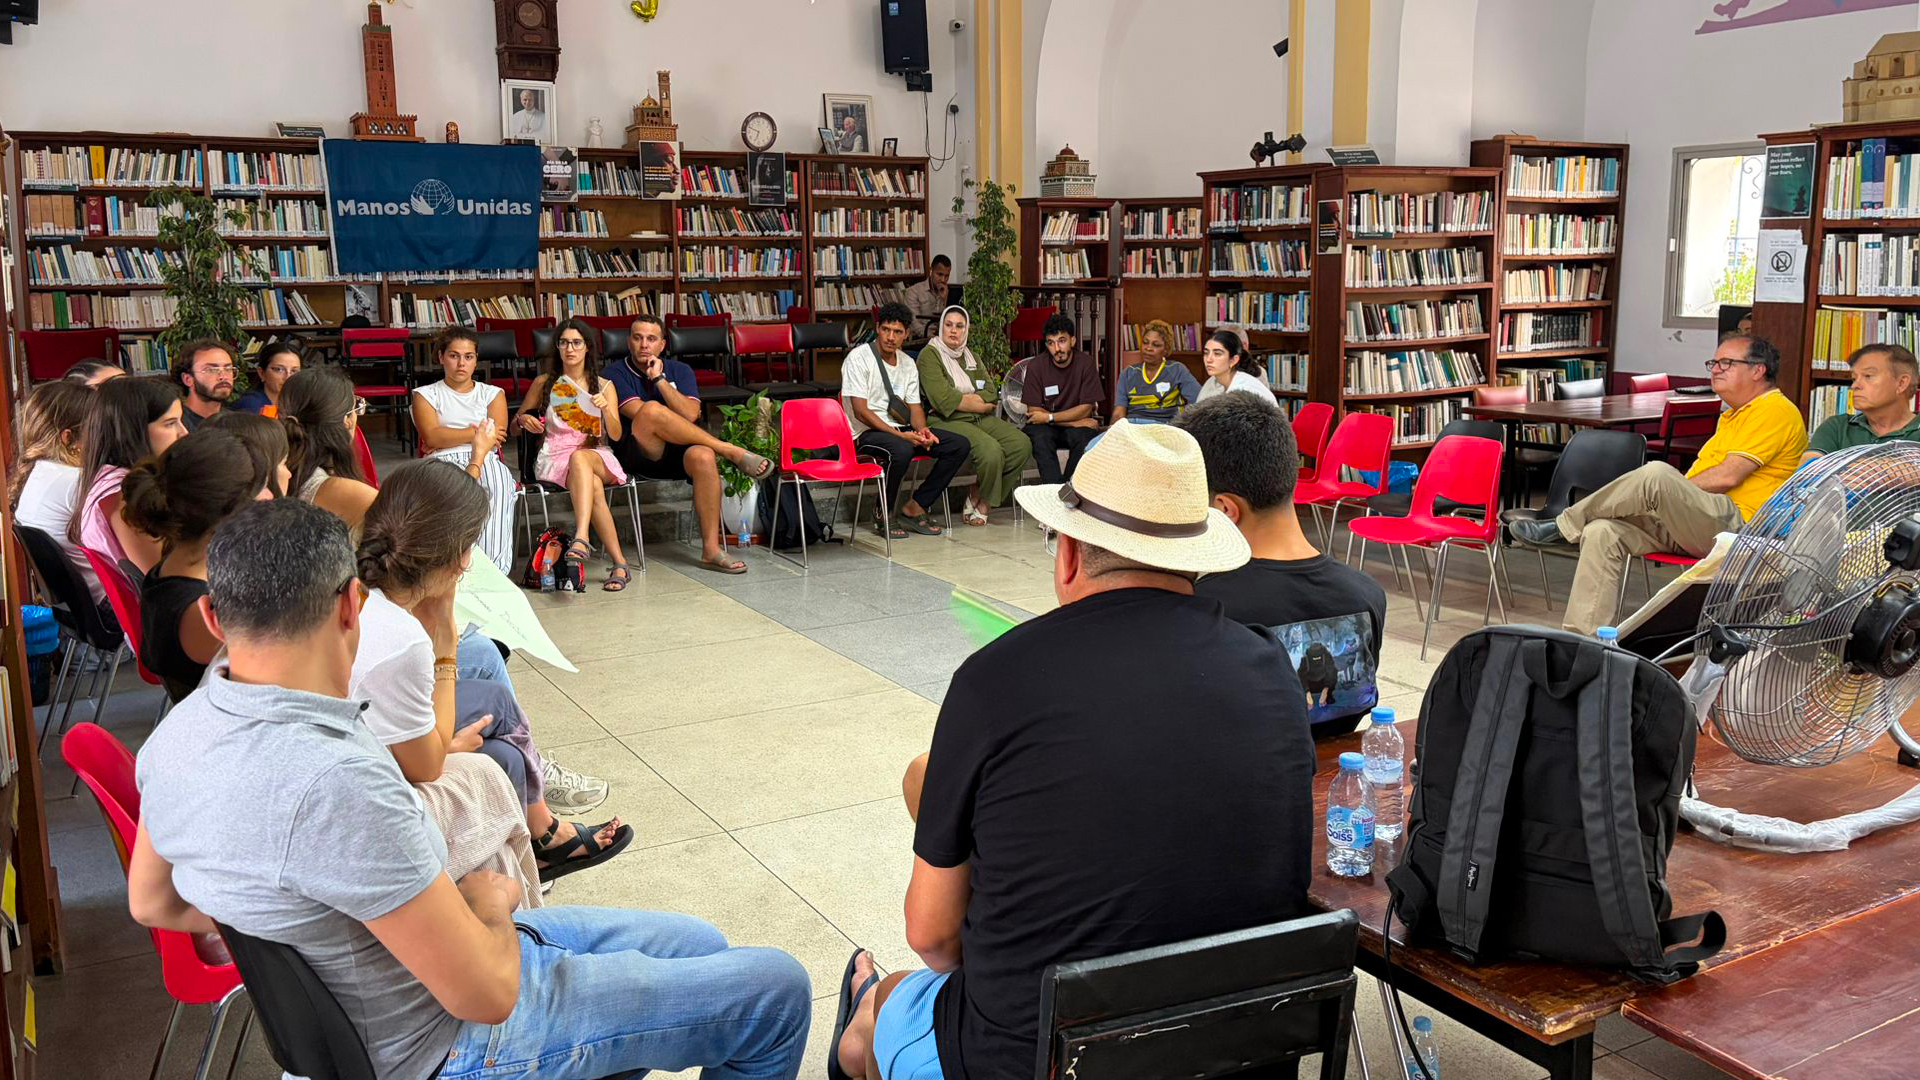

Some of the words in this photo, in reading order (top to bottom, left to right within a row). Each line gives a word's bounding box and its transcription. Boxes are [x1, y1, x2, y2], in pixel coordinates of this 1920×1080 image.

[543, 165, 572, 174] CERO
[337, 199, 411, 216] Manos
[457, 198, 532, 215] Unidas
